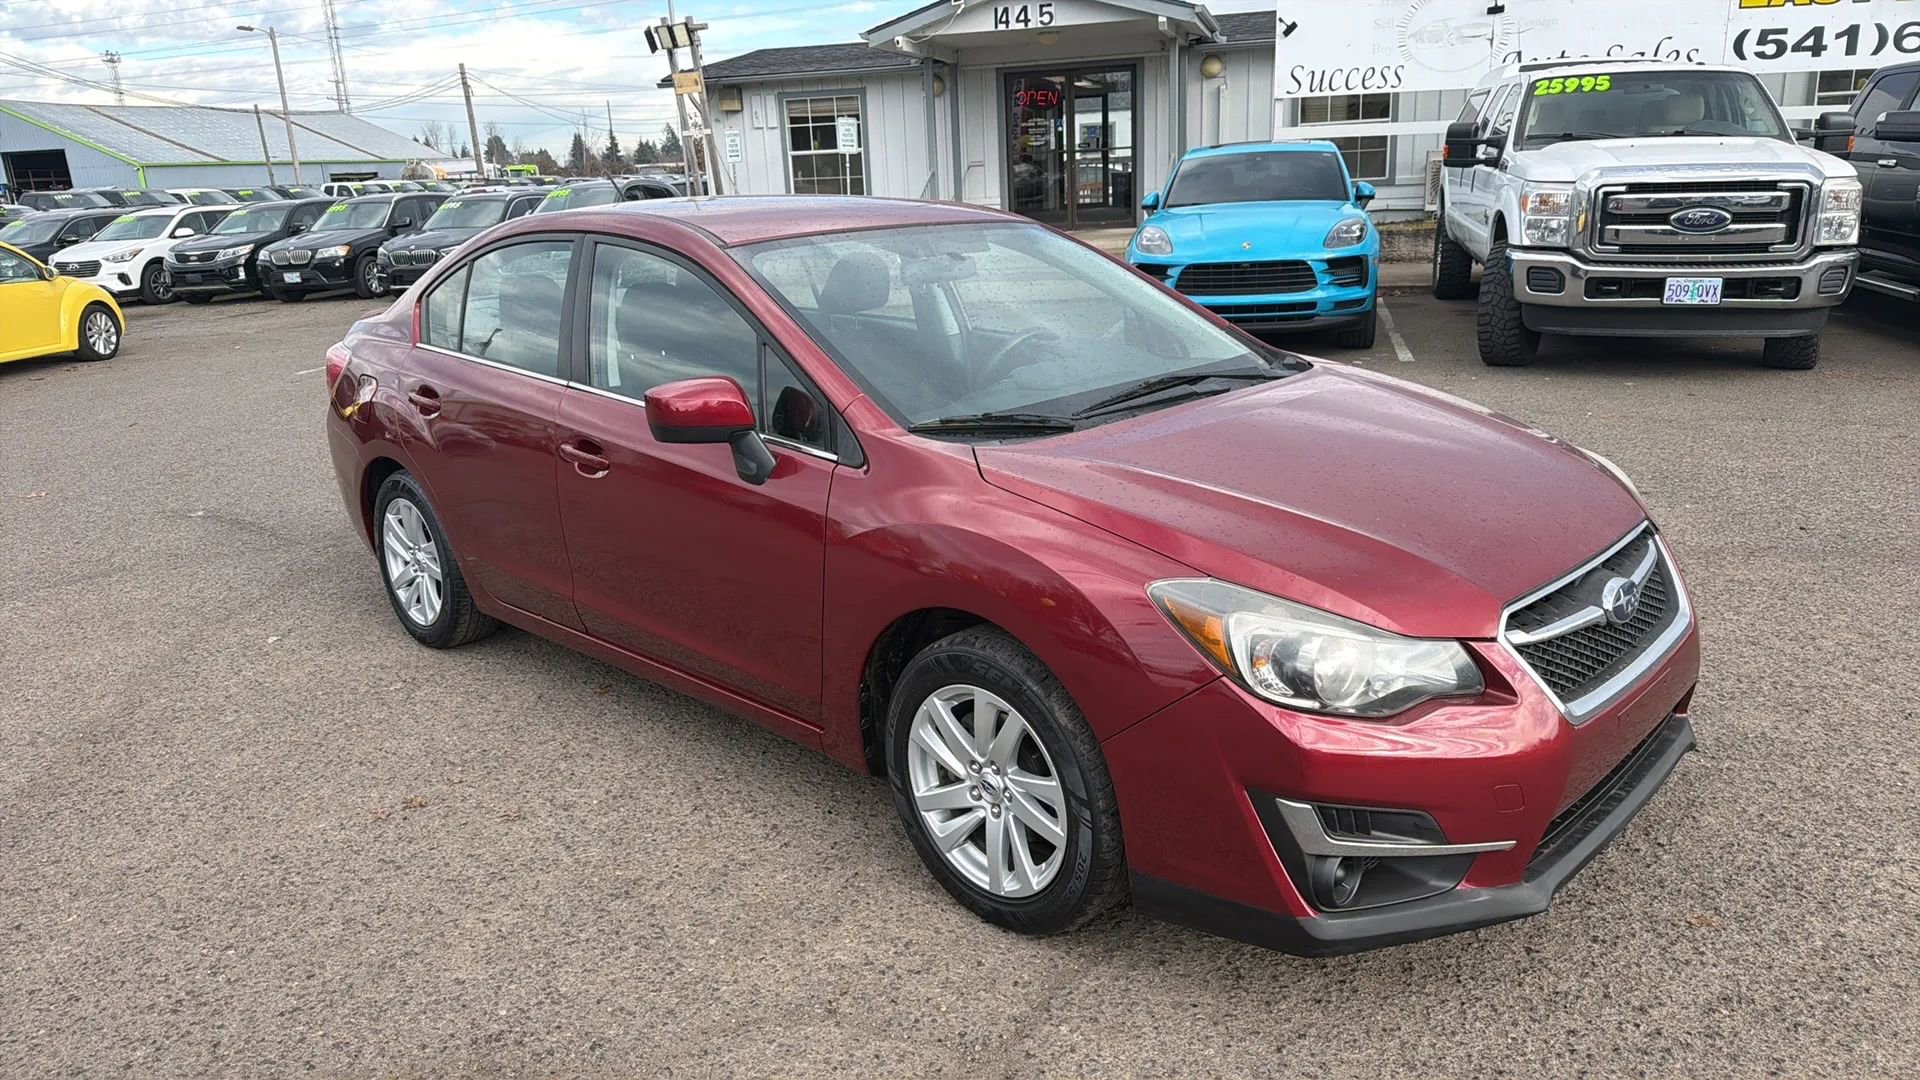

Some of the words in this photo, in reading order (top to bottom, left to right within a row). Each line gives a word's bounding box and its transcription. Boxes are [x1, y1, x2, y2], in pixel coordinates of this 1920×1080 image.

[994, 3, 1054, 30] 1445
[1285, 64, 1405, 95] Success
[1533, 75, 1611, 96] 25995
[1016, 90, 1058, 105] OPEN
[1684, 211, 1719, 226] Ford
[1668, 284, 1690, 298] 509
